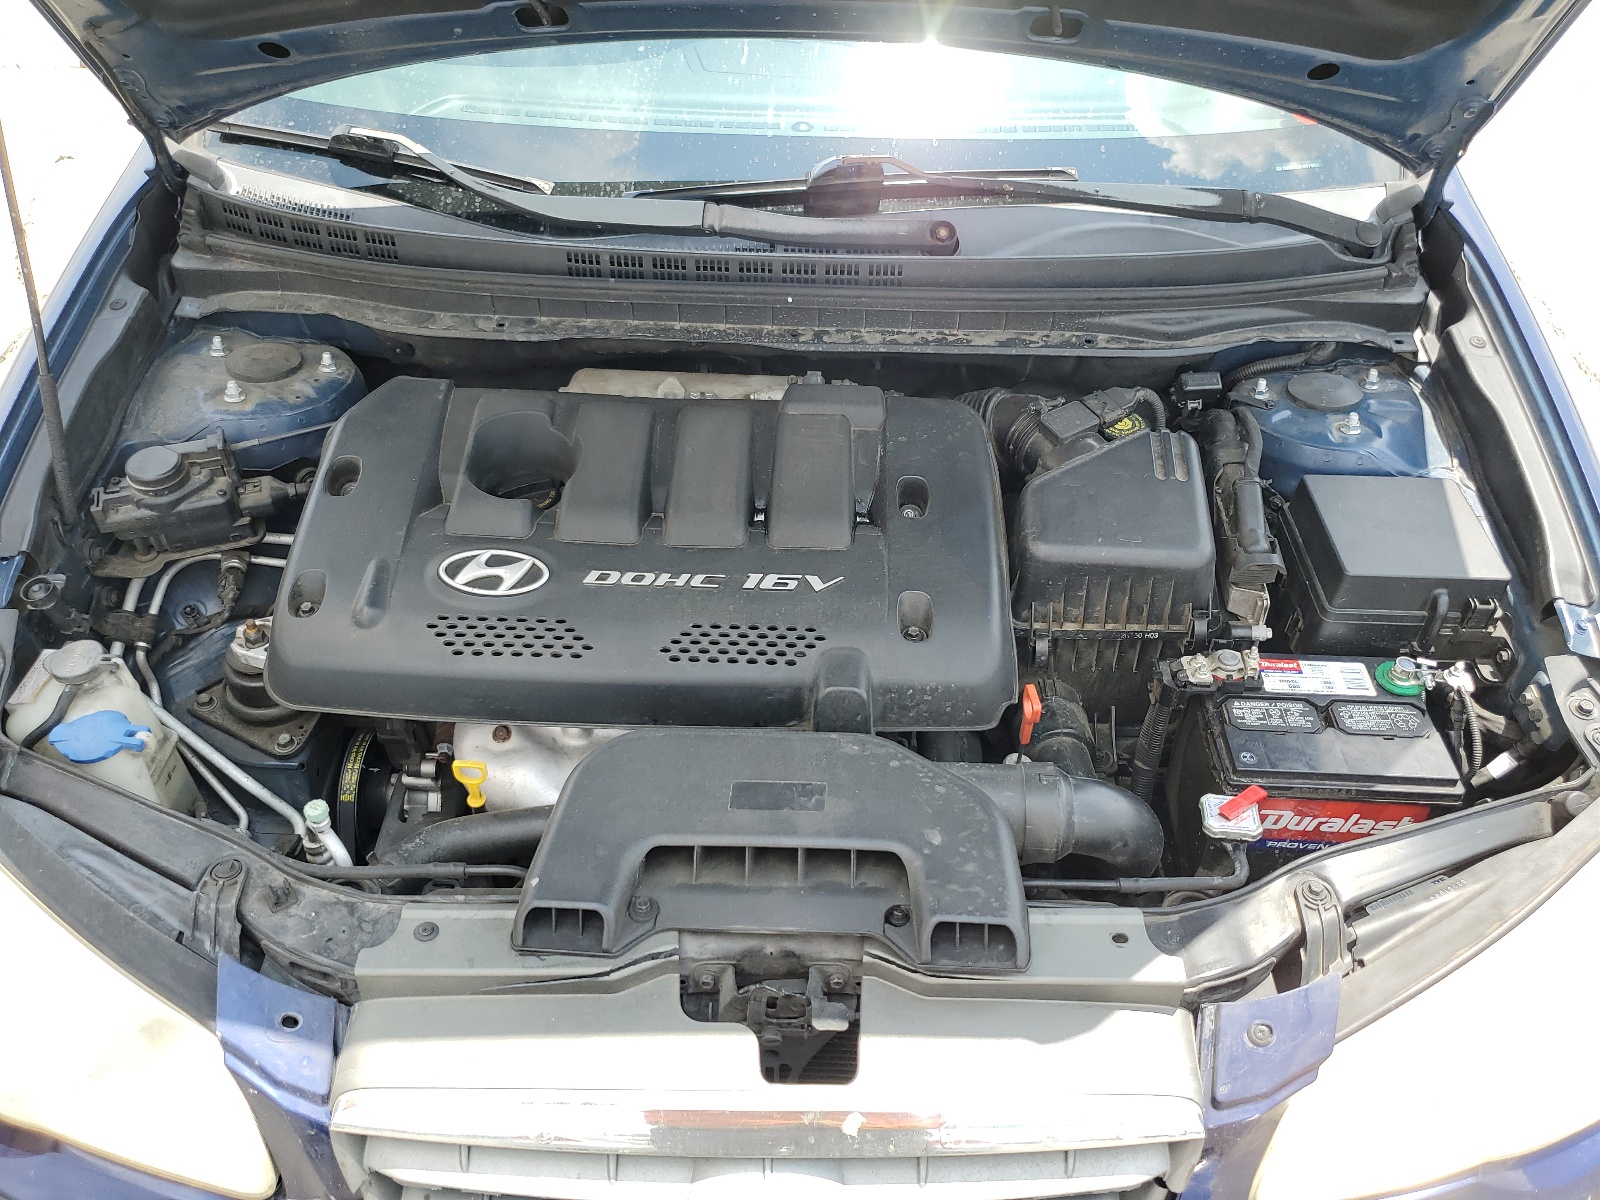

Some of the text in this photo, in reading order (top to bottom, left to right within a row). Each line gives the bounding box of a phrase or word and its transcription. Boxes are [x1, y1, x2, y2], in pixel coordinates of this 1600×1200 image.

[582, 569, 845, 593] DOHC 16V
[1259, 661, 1298, 669] Duralast
[1259, 809, 1414, 834] Duralast
[1265, 840, 1331, 850] PROVEN
